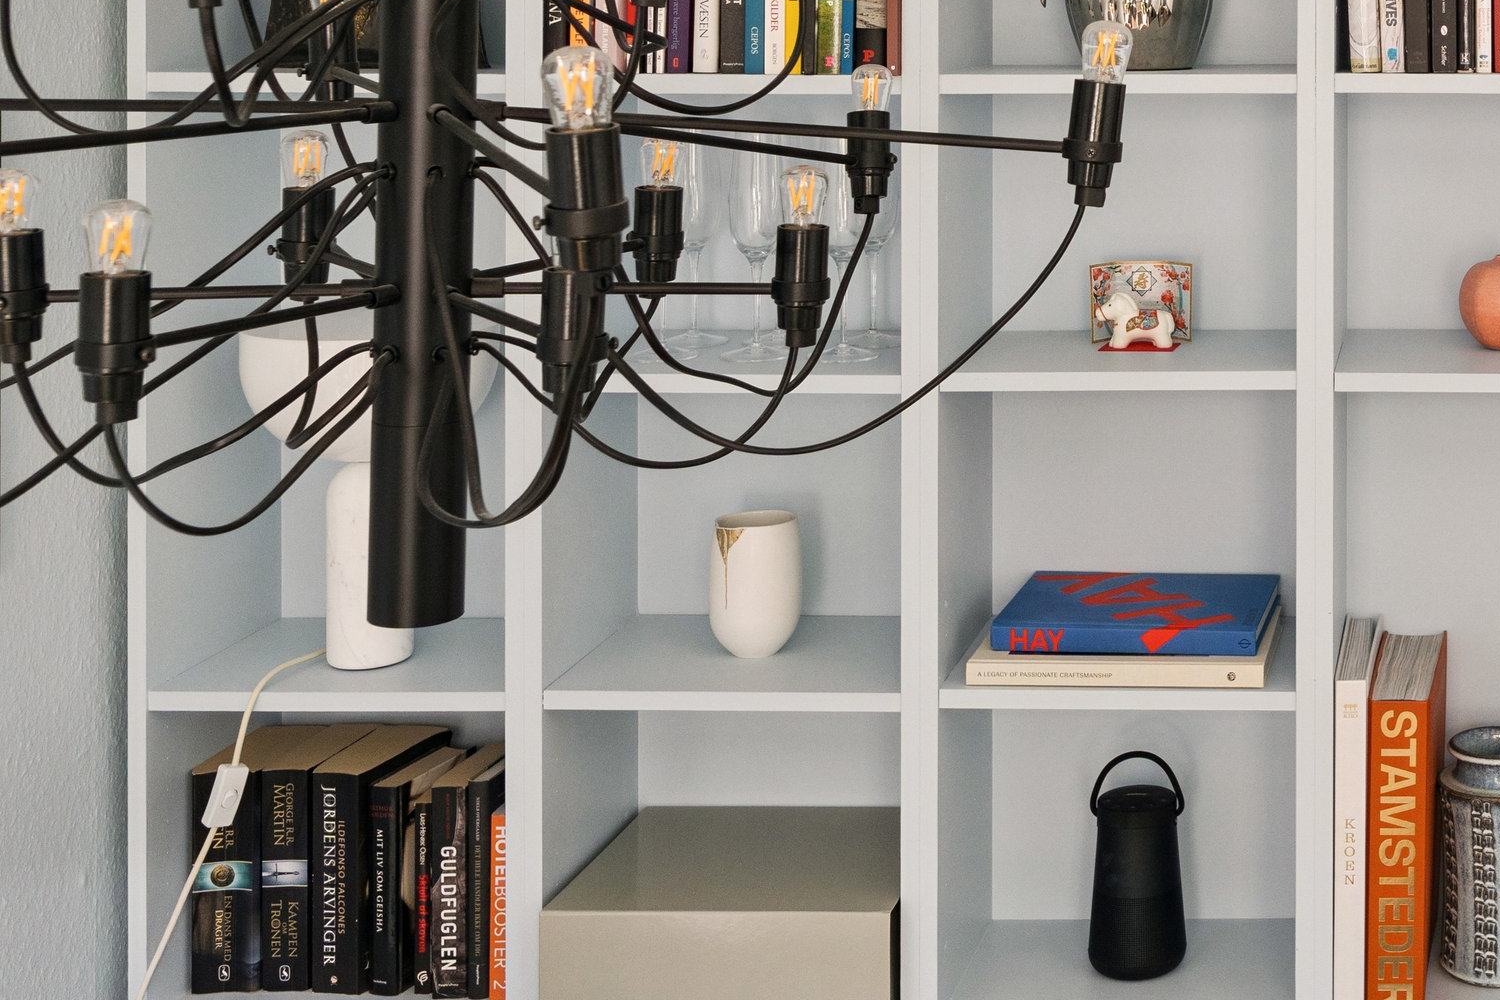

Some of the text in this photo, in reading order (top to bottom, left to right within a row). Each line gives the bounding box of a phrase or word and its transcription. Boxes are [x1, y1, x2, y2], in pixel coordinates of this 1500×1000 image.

[750, 26, 759, 54] CEPOS
[1009, 628, 1065, 652] HAY
[273, 784, 285, 846] MARTIN
[321, 784, 336, 966] JORDENS ARVINGER
[337, 820, 346, 935] ILDEFONSO FALCONES
[376, 828, 384, 933] MIT LIV SOM GEISHA
[1344, 818, 1357, 886] KROEN
[215, 909, 224, 949] DRAGER
[224, 895, 233, 961] EN DANS MED
[270, 899, 282, 958] TRONEN
[282, 921, 289, 934] OM
[288, 901, 299, 958] KAMPEN
[440, 845, 457, 971] GULDFUGLEN
[493, 979, 506, 990] 2
